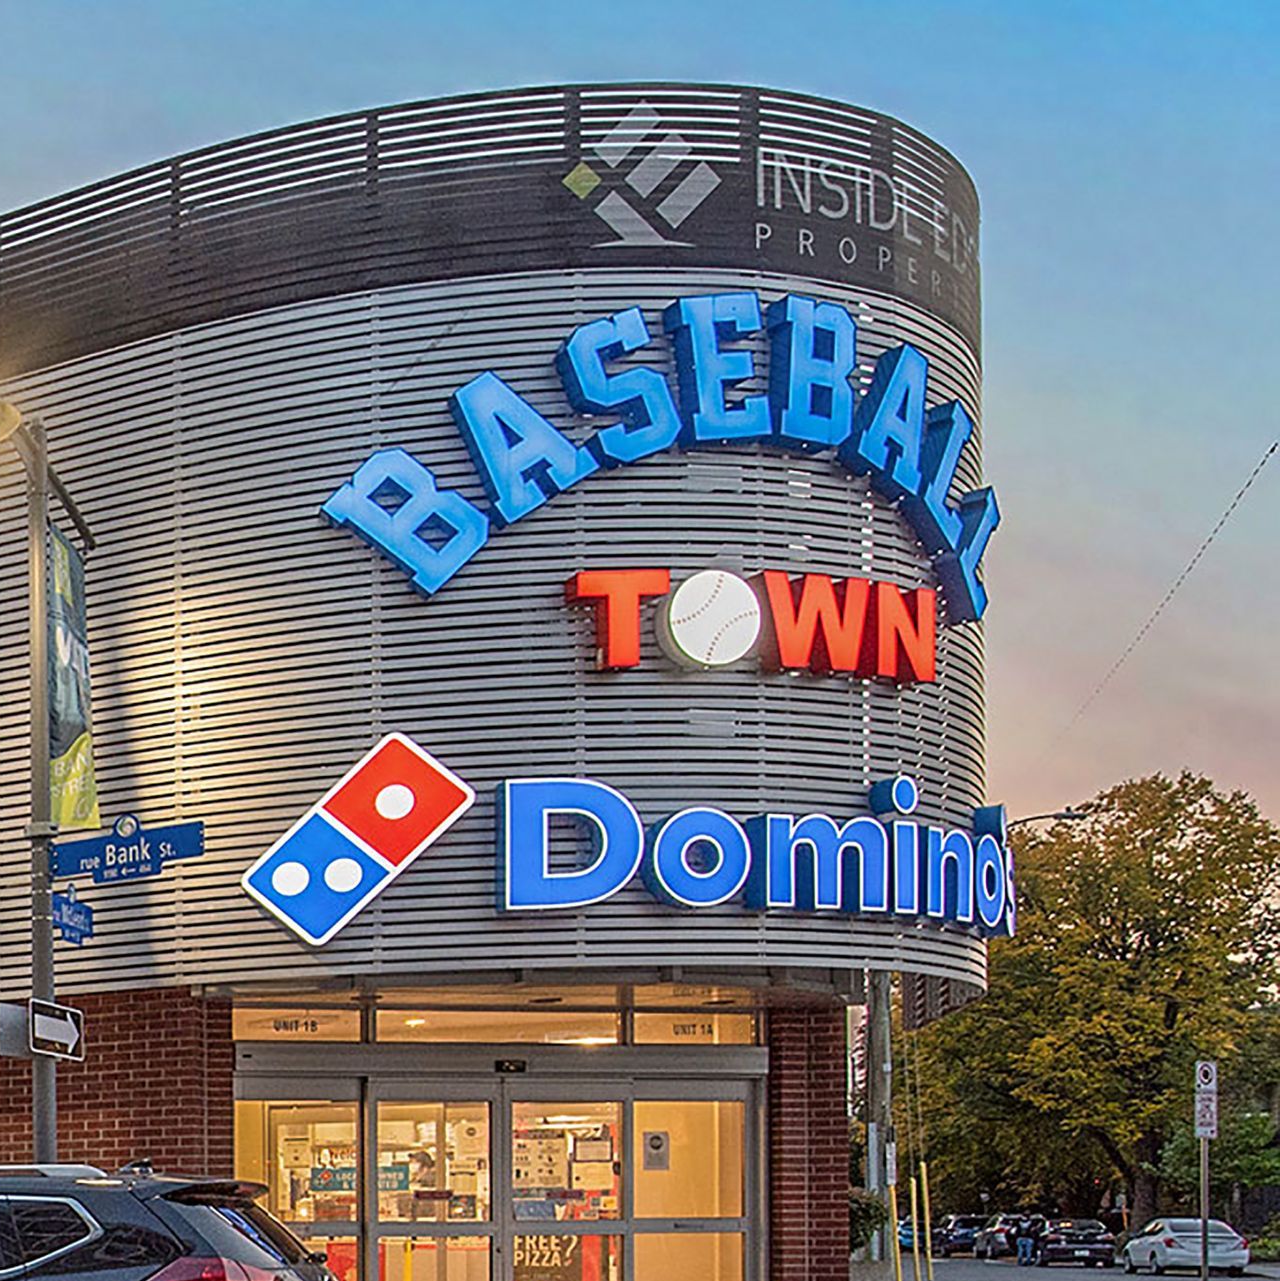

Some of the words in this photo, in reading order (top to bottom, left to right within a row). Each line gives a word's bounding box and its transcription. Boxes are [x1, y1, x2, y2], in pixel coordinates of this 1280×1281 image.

[756, 147, 922, 246] INSIDE
[754, 222, 945, 298] PROPER
[320, 292, 1001, 625] BASEBALL
[566, 566, 937, 684] TOWN
[53, 750, 91, 777] BAN
[80, 857, 101, 871] rue
[105, 837, 151, 867] Bank
[497, 774, 1017, 938] Domino'
[673, 1023, 697, 1037] UNIT
[513, 1235, 562, 1251] FREE
